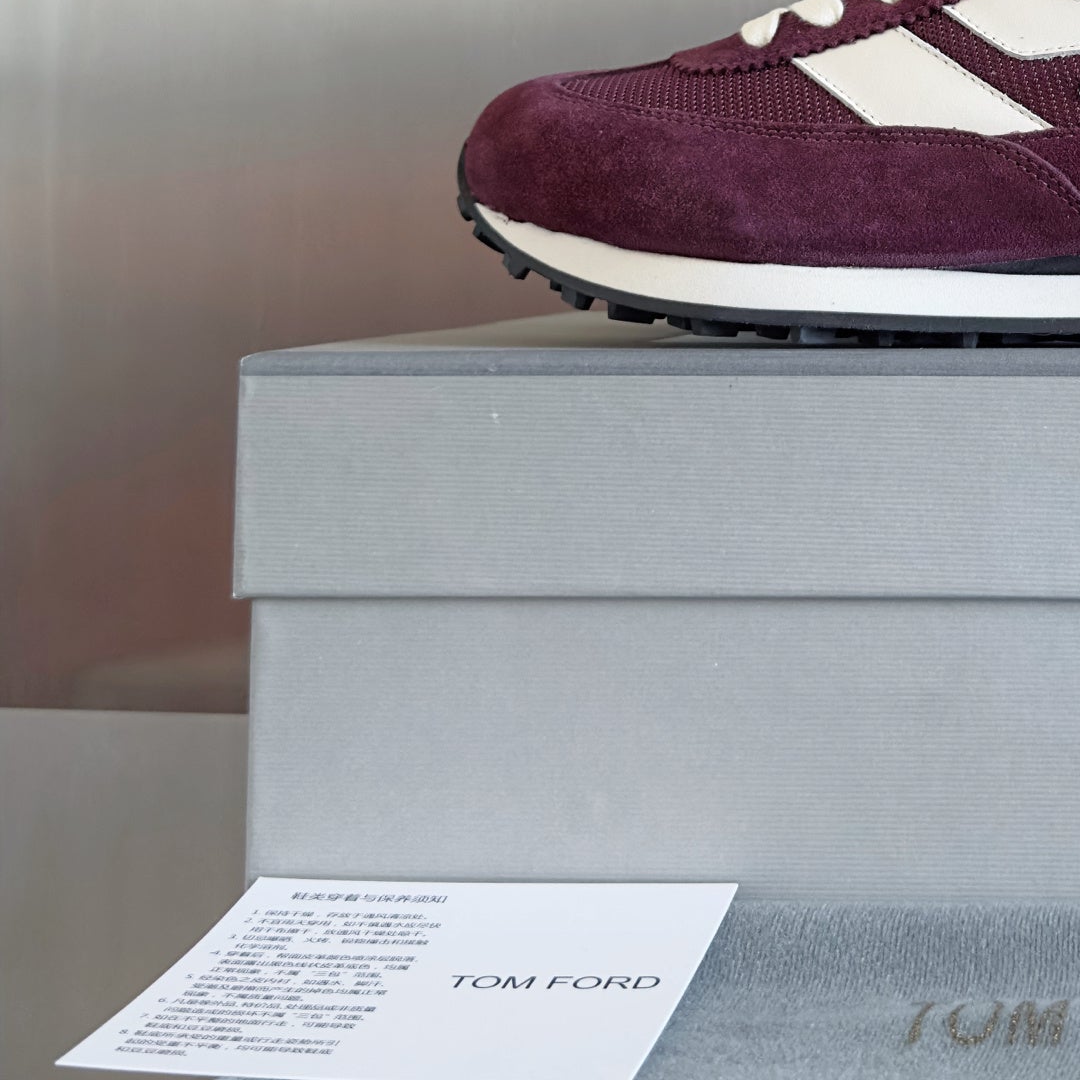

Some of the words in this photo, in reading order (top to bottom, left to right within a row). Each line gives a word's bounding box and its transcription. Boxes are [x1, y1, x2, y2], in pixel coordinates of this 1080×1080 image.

[291, 892, 448, 903] 鞋类穿着与保养须知
[452, 975, 537, 990] TOM
[546, 975, 661, 990] FORD
[902, 999, 1069, 1047] TOM
